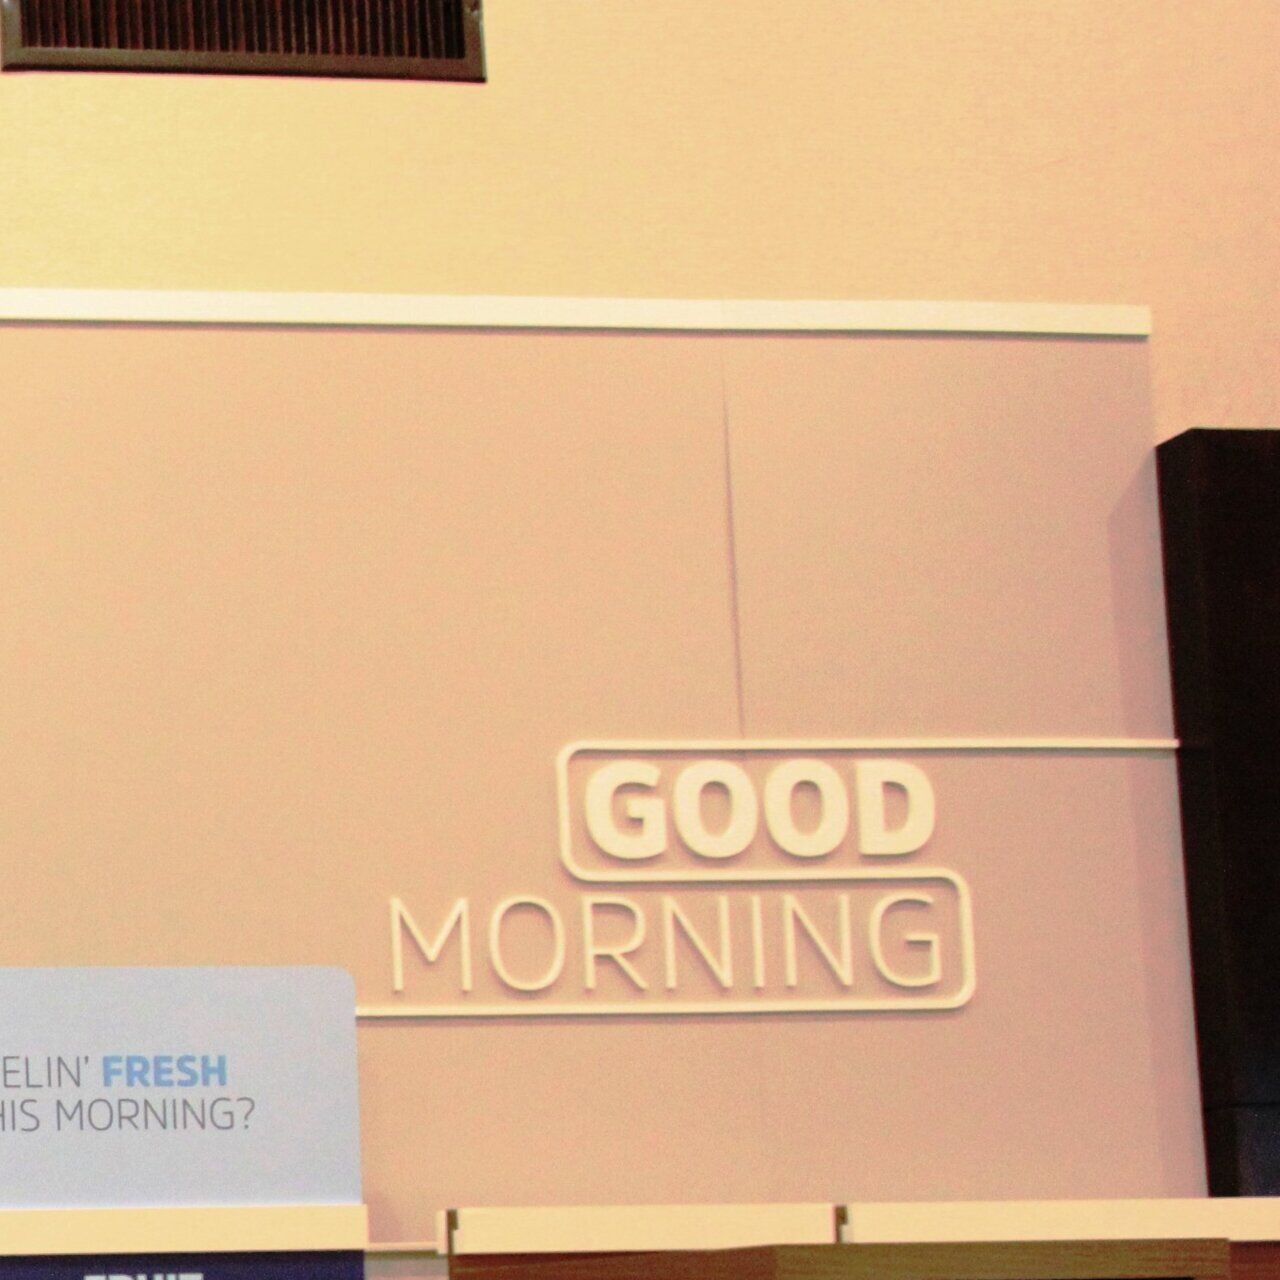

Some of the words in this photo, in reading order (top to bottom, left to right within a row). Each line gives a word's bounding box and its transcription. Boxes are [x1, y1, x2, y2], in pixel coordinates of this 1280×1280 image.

[584, 758, 936, 859] GOOD
[388, 894, 943, 992] MORNING
[102, 1054, 227, 1088] FRESH
[55, 1096, 256, 1131] MORNING?
